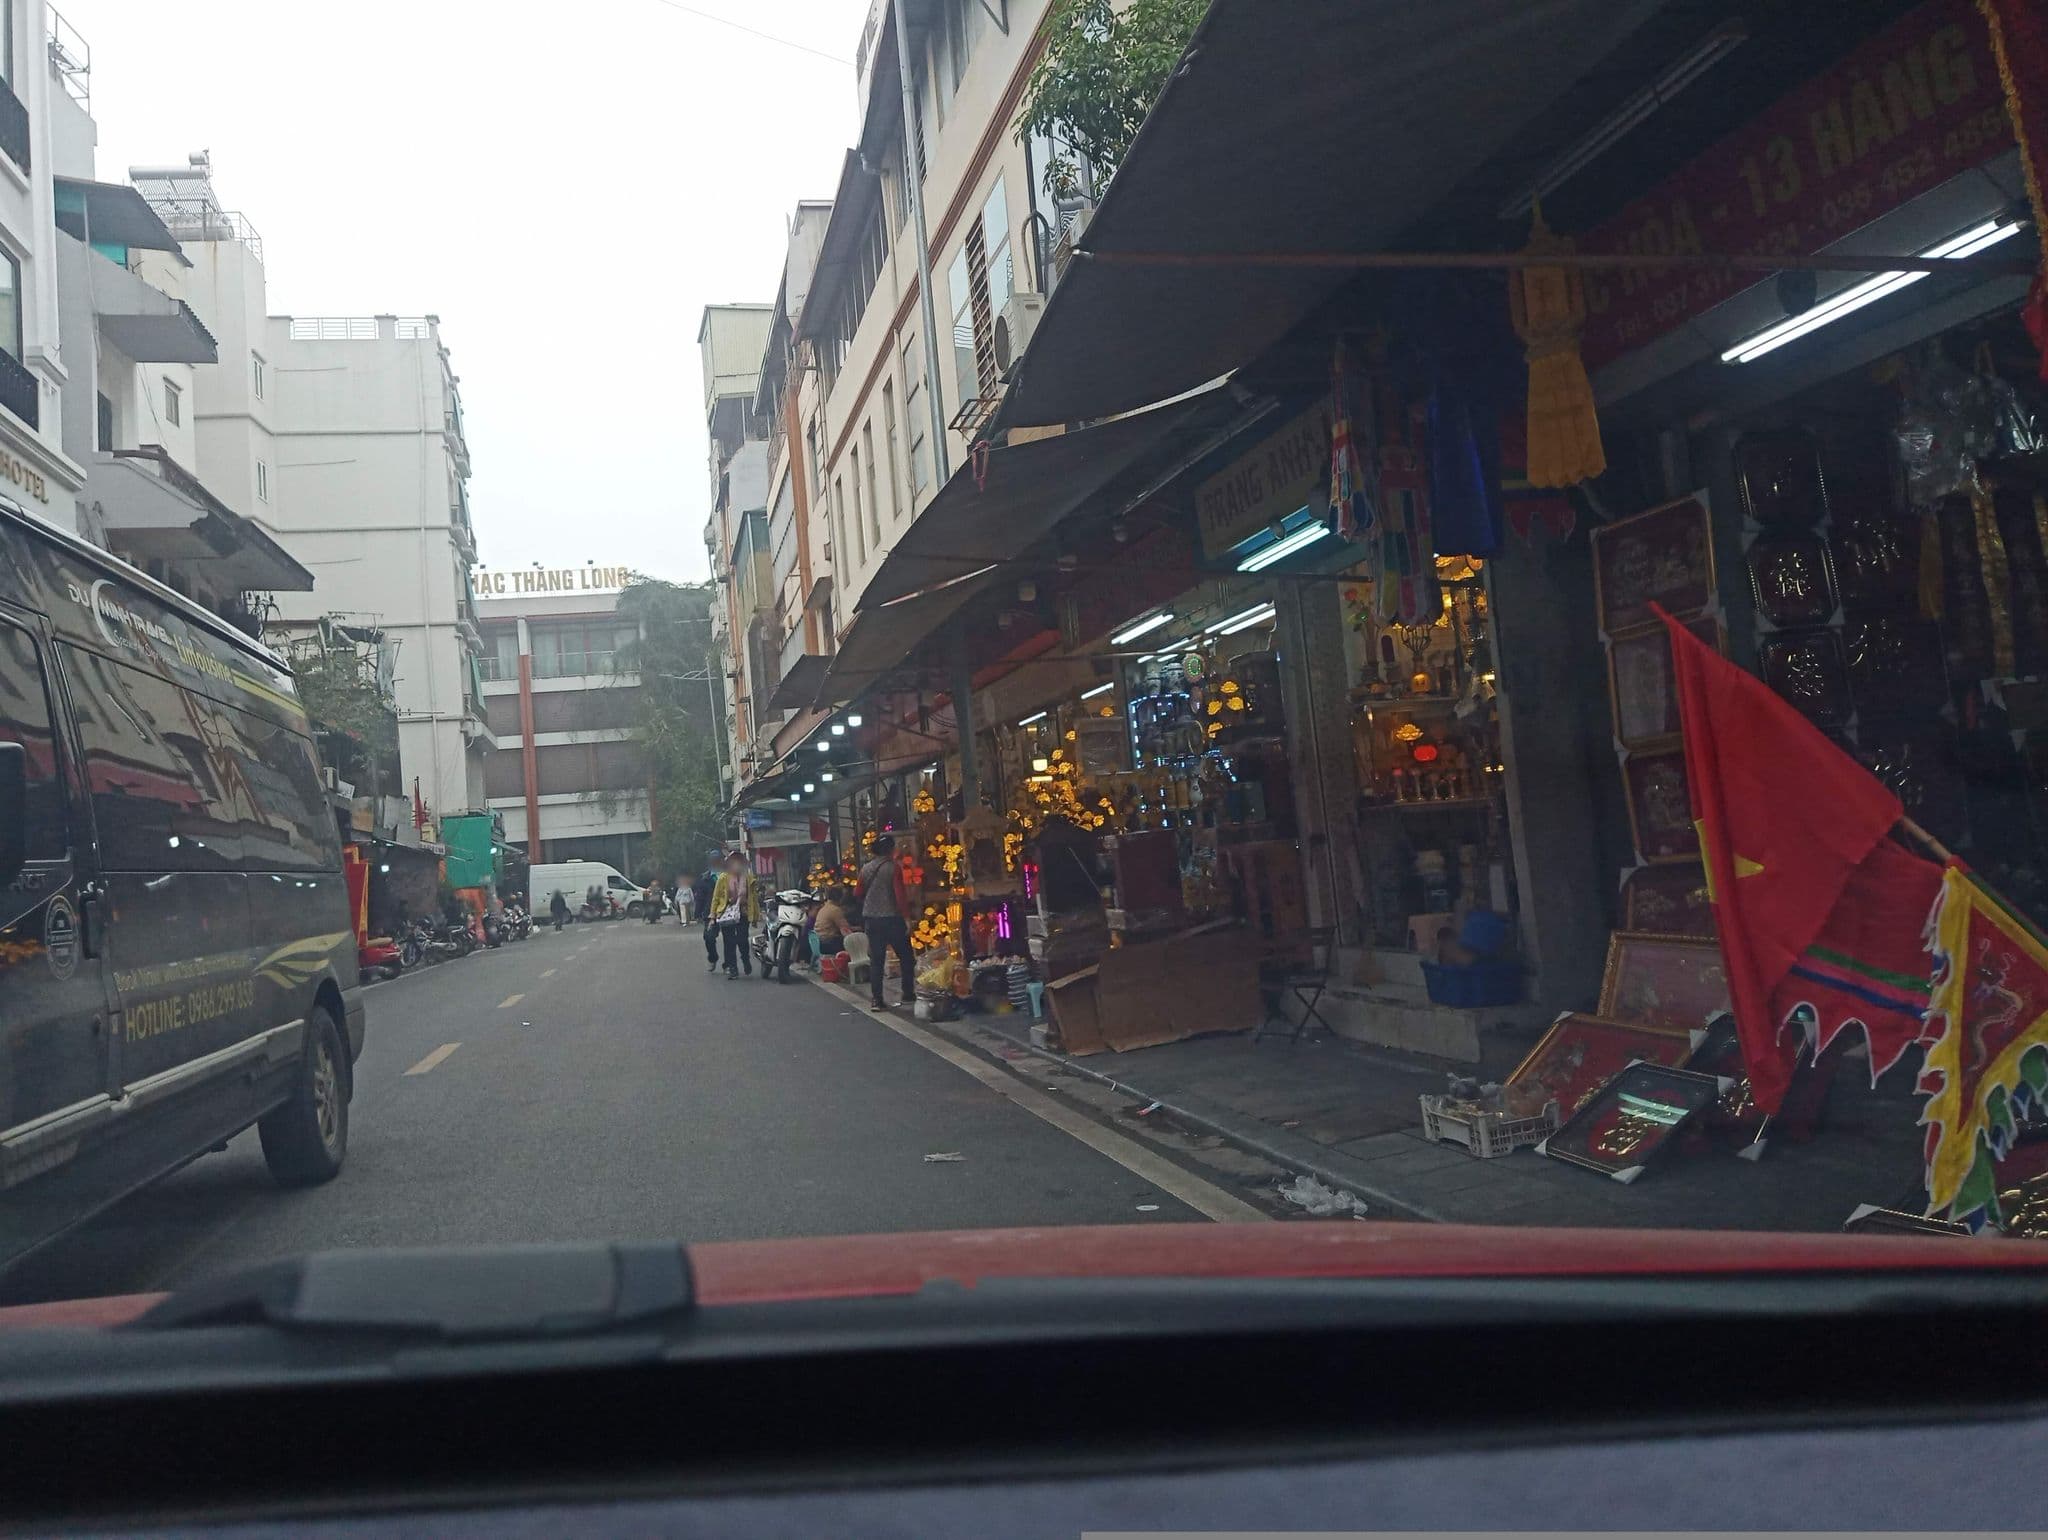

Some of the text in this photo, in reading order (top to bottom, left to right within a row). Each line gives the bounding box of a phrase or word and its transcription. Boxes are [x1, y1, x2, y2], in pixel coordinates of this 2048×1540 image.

[1809, 23, 1978, 177] HÀNG
[511, 565, 574, 593] THĂNG
[124, 994, 186, 1043] HOTLINE:
